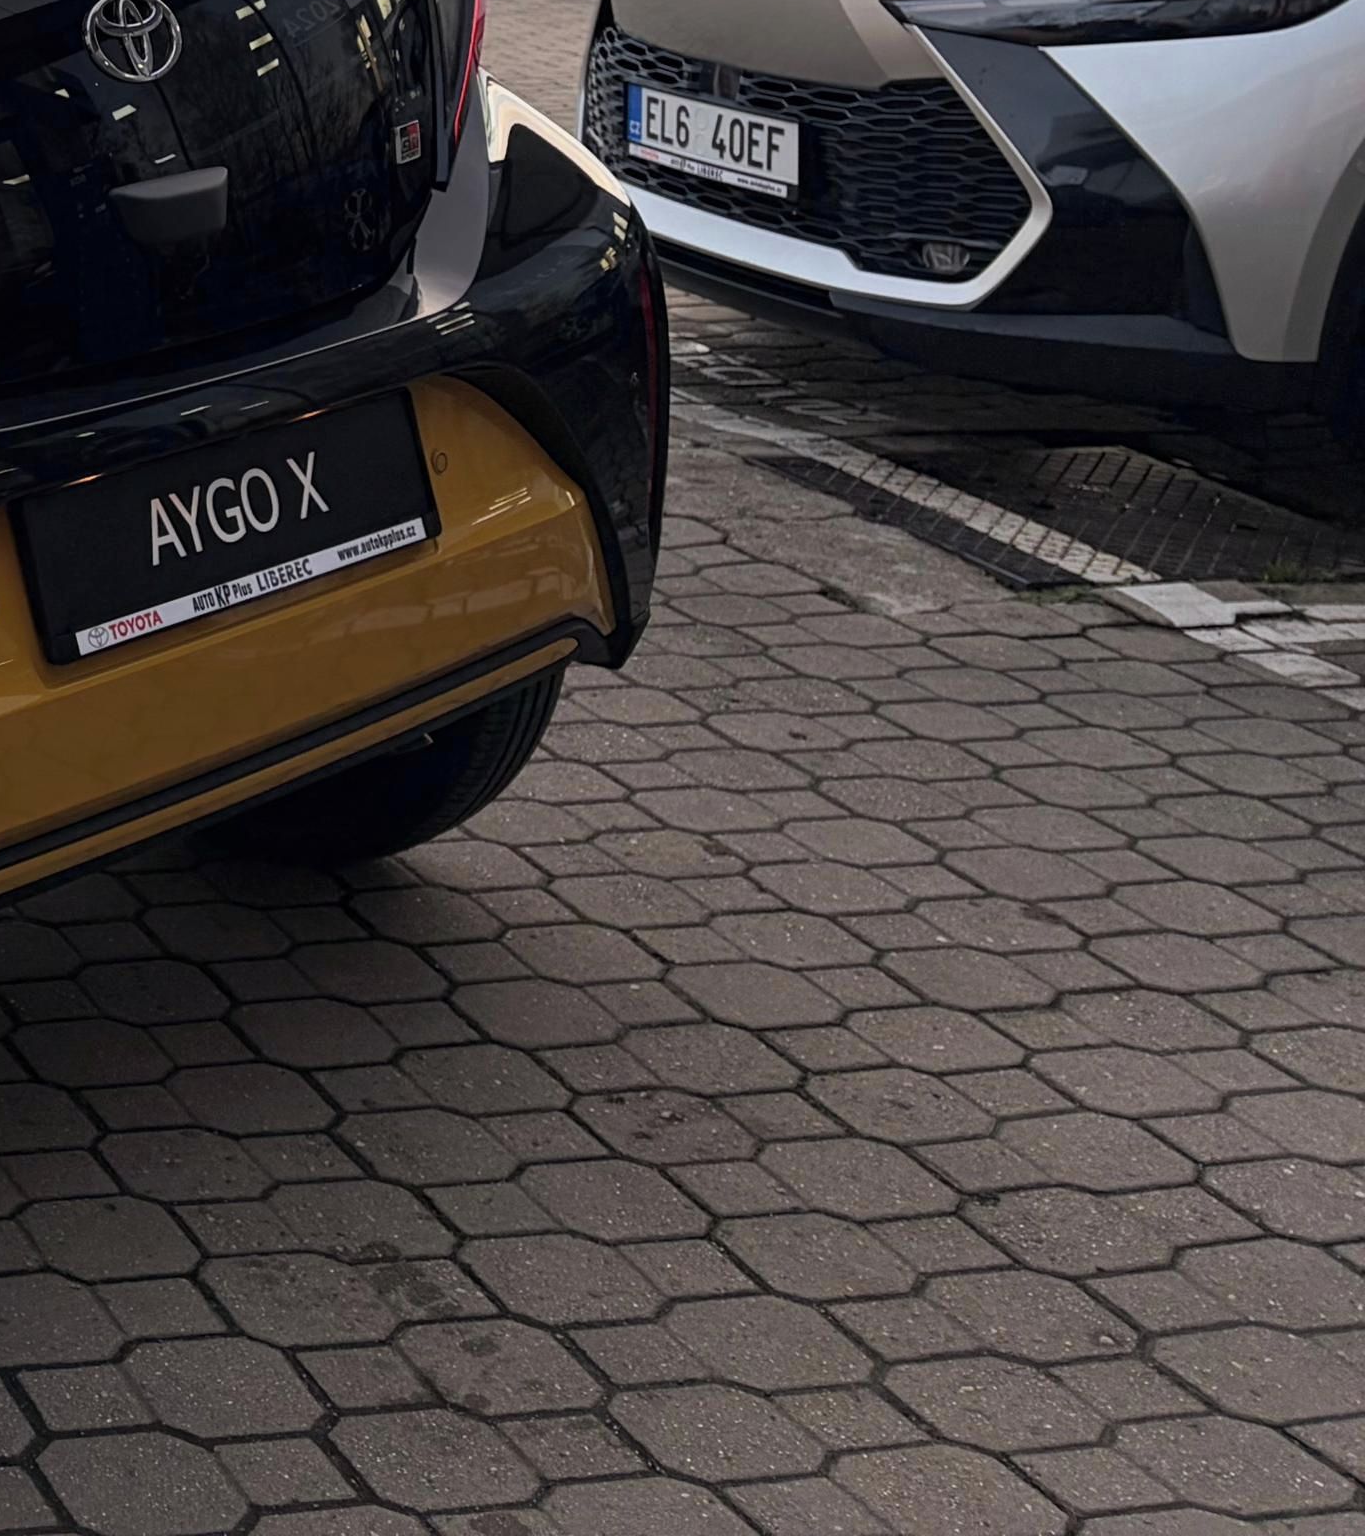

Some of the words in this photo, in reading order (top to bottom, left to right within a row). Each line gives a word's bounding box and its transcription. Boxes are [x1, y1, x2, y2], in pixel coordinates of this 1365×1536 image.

[646, 95, 691, 149] EL6
[711, 114, 785, 172] 40EF
[150, 467, 280, 567] AYGO
[286, 451, 331, 520] X
[109, 610, 163, 641] TOYOTA
[192, 592, 216, 613] AUTO
[214, 584, 231, 608] KP
[233, 582, 253, 601] Plus
[256, 559, 313, 592] LIBEREC
[337, 525, 417, 561] www.autokpplus.cz
